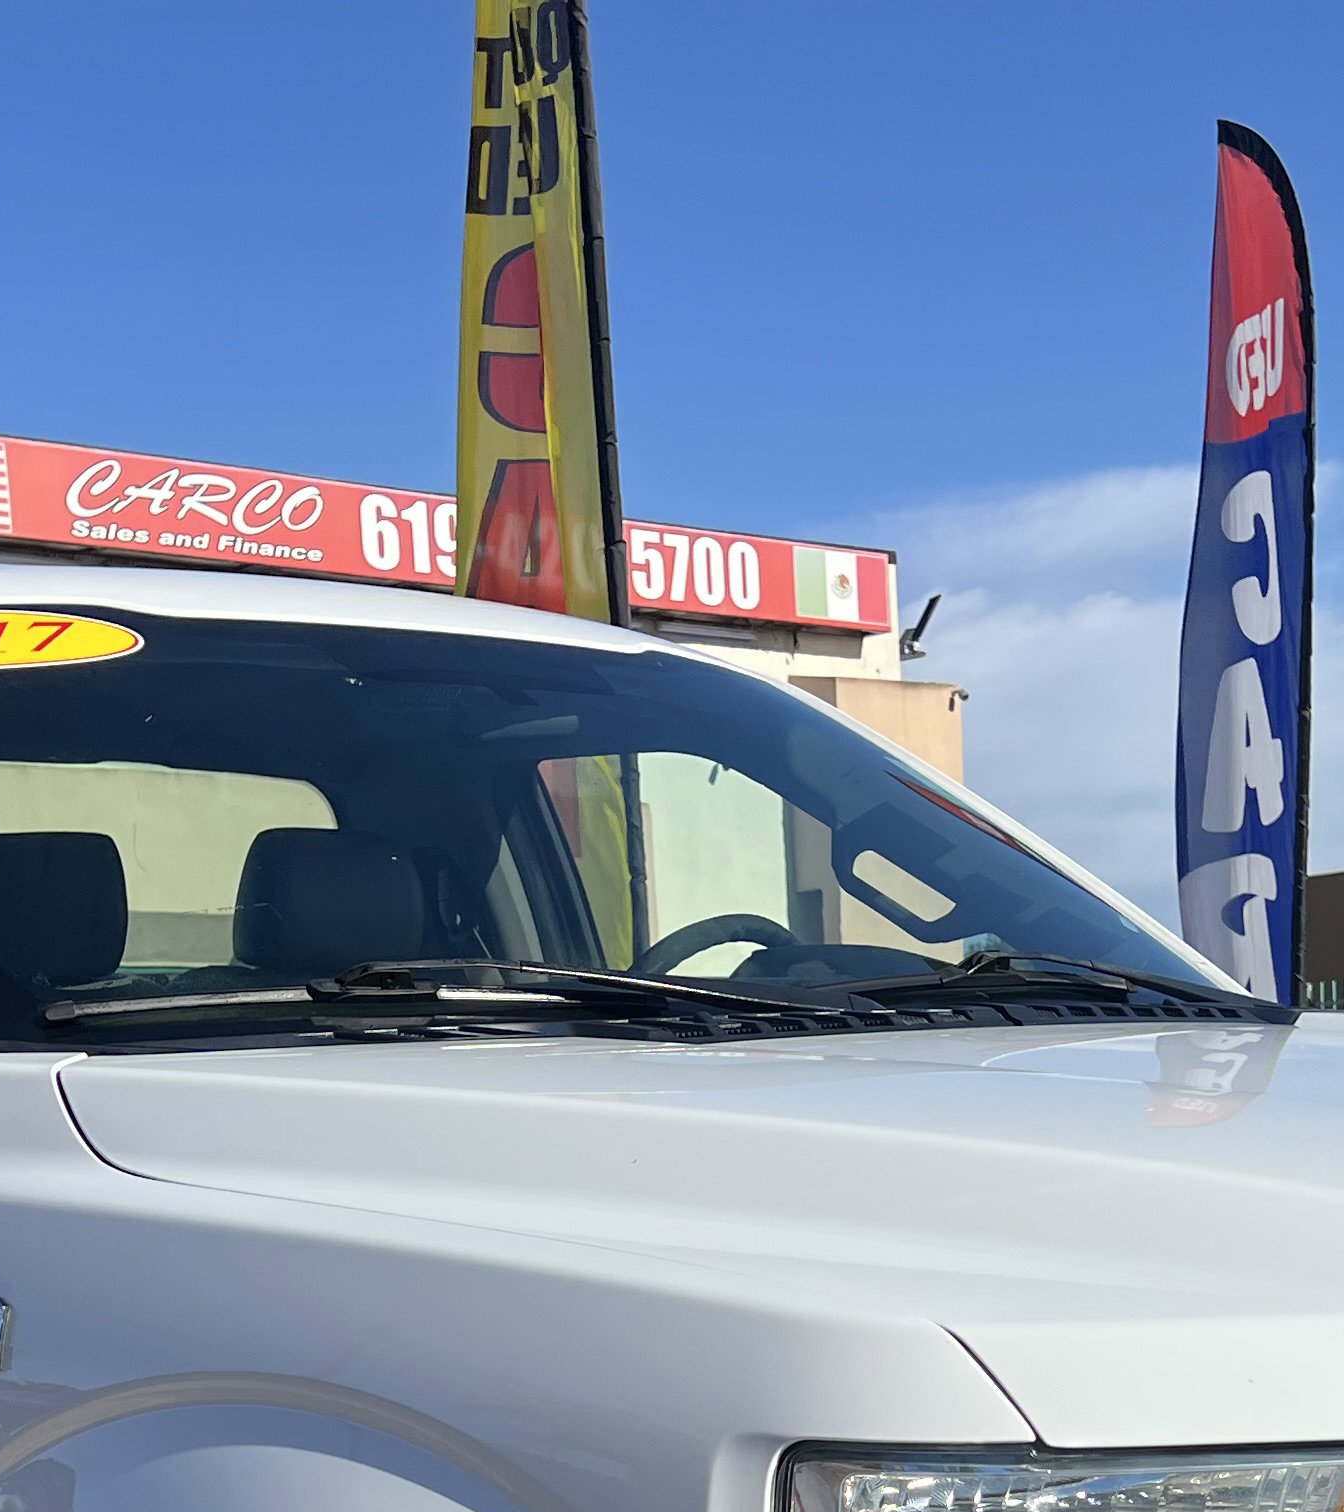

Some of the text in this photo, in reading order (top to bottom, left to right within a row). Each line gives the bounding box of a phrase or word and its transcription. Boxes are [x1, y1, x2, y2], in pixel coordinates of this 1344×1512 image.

[66, 459, 324, 535] CARCO
[360, 493, 457, 577] 619
[630, 528, 761, 610] 5700
[71, 520, 323, 562] Sales and Finance
